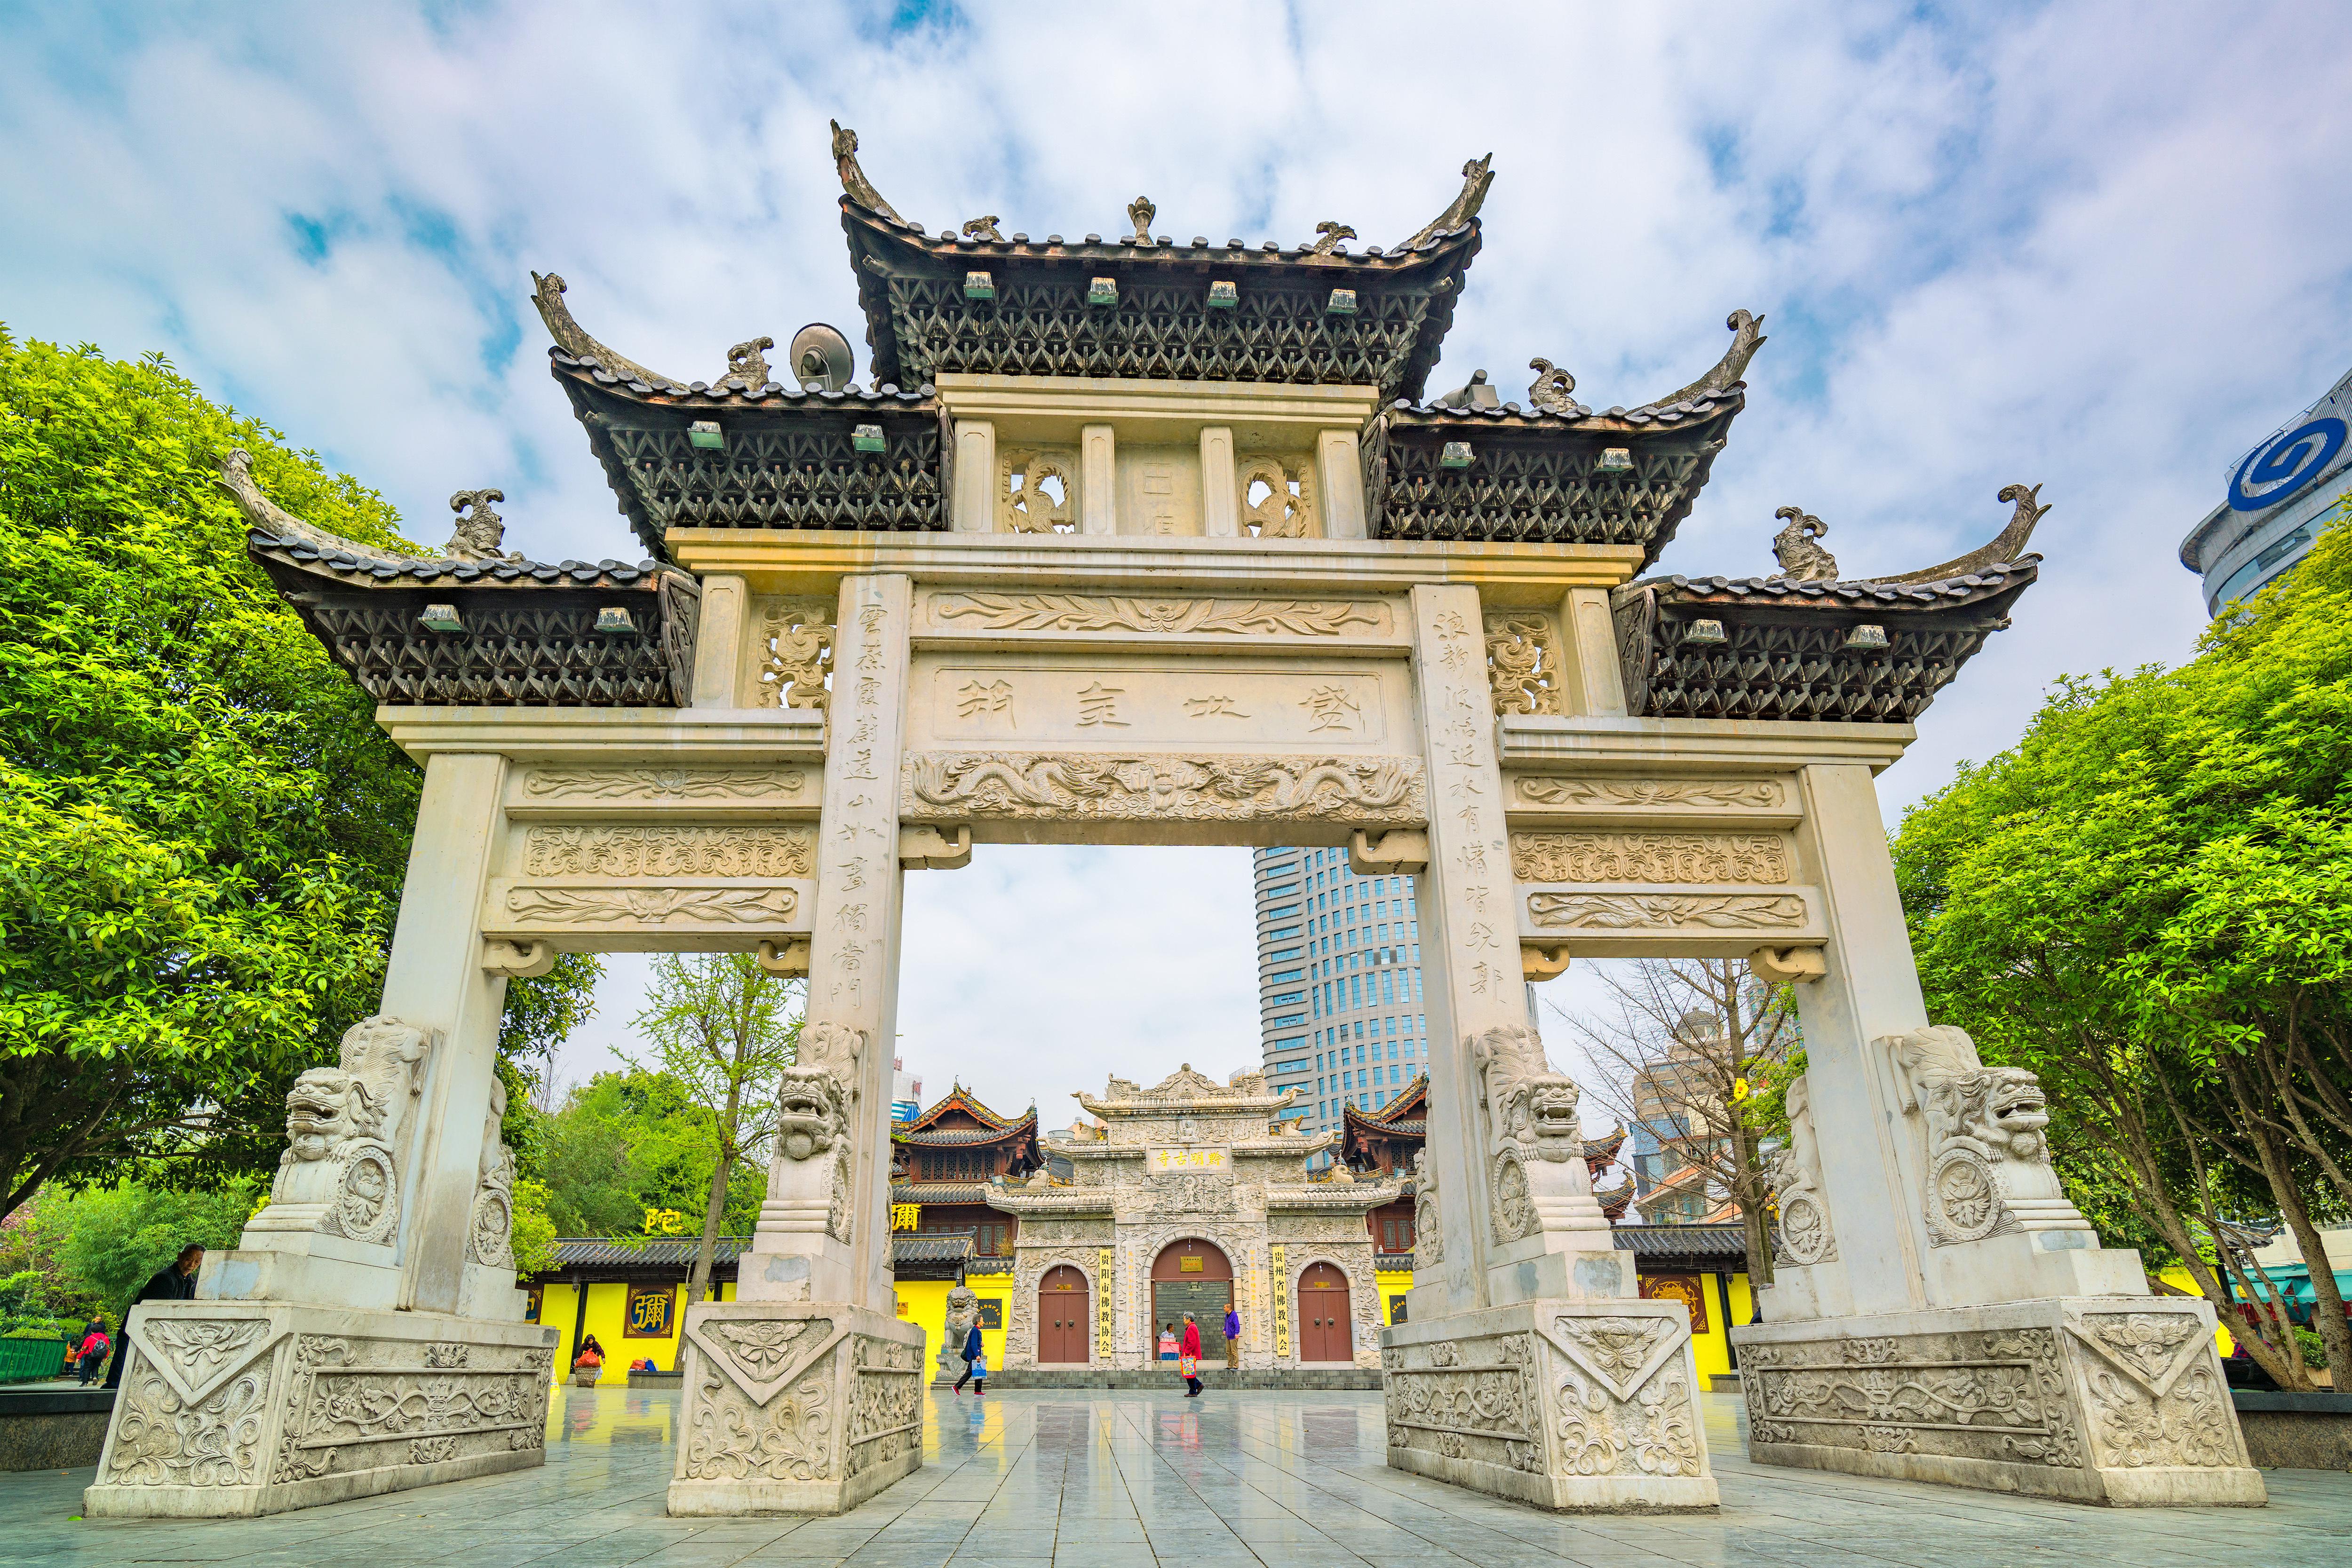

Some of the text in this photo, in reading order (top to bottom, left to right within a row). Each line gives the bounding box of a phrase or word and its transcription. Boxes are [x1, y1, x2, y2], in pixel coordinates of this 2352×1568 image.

[1157, 1150, 1225, 1167] 黔明古寺
[632, 1294, 668, 1329] 彌
[1101, 1254, 1110, 1352] 贵阳市佛教协会
[1275, 1252, 1287, 1350] 贵州省佛教协会
